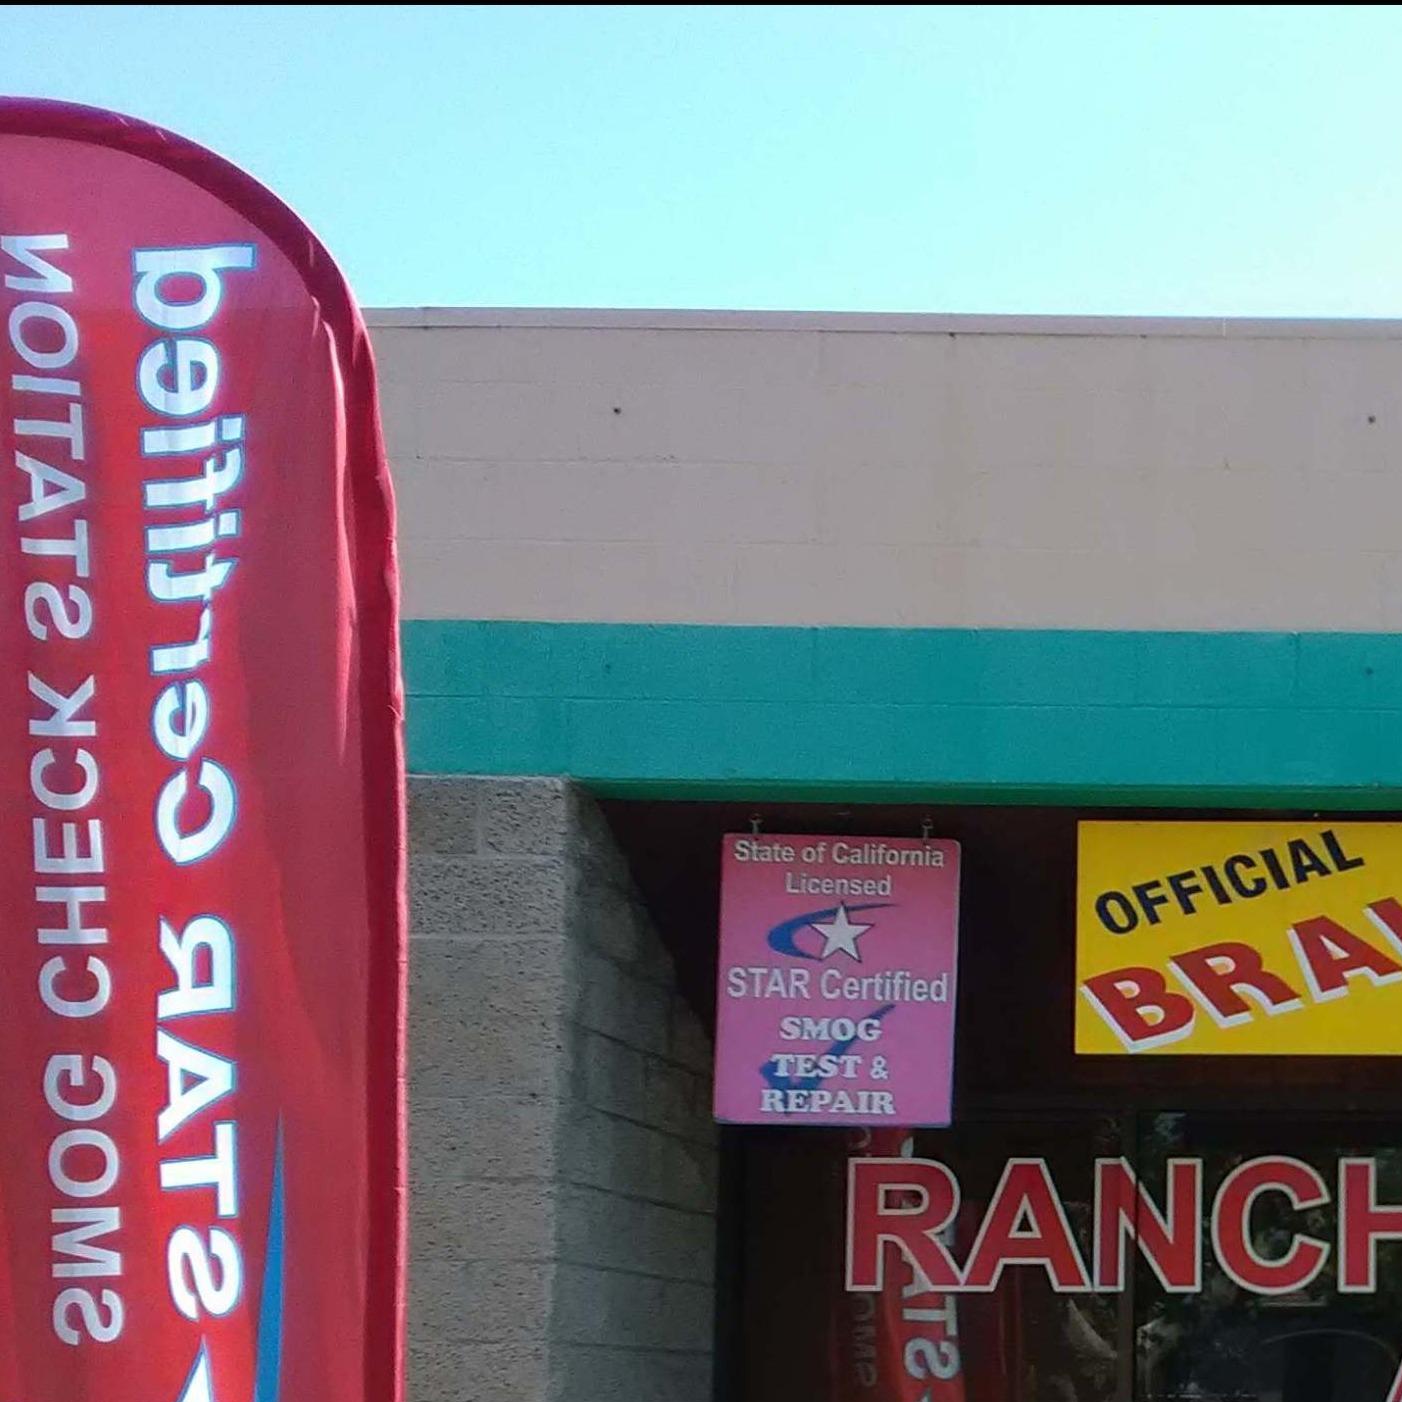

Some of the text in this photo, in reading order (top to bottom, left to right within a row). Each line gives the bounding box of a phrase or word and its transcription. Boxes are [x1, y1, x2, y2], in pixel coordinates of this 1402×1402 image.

[734, 840, 945, 867] State of California
[785, 873, 892, 896] Licensed
[1094, 829, 1365, 935] OFFICIAL
[727, 967, 948, 1002] STAR Certified
[779, 1016, 883, 1042] SMOG
[769, 1053, 889, 1080] TEST &
[760, 1089, 896, 1114] REPAIR
